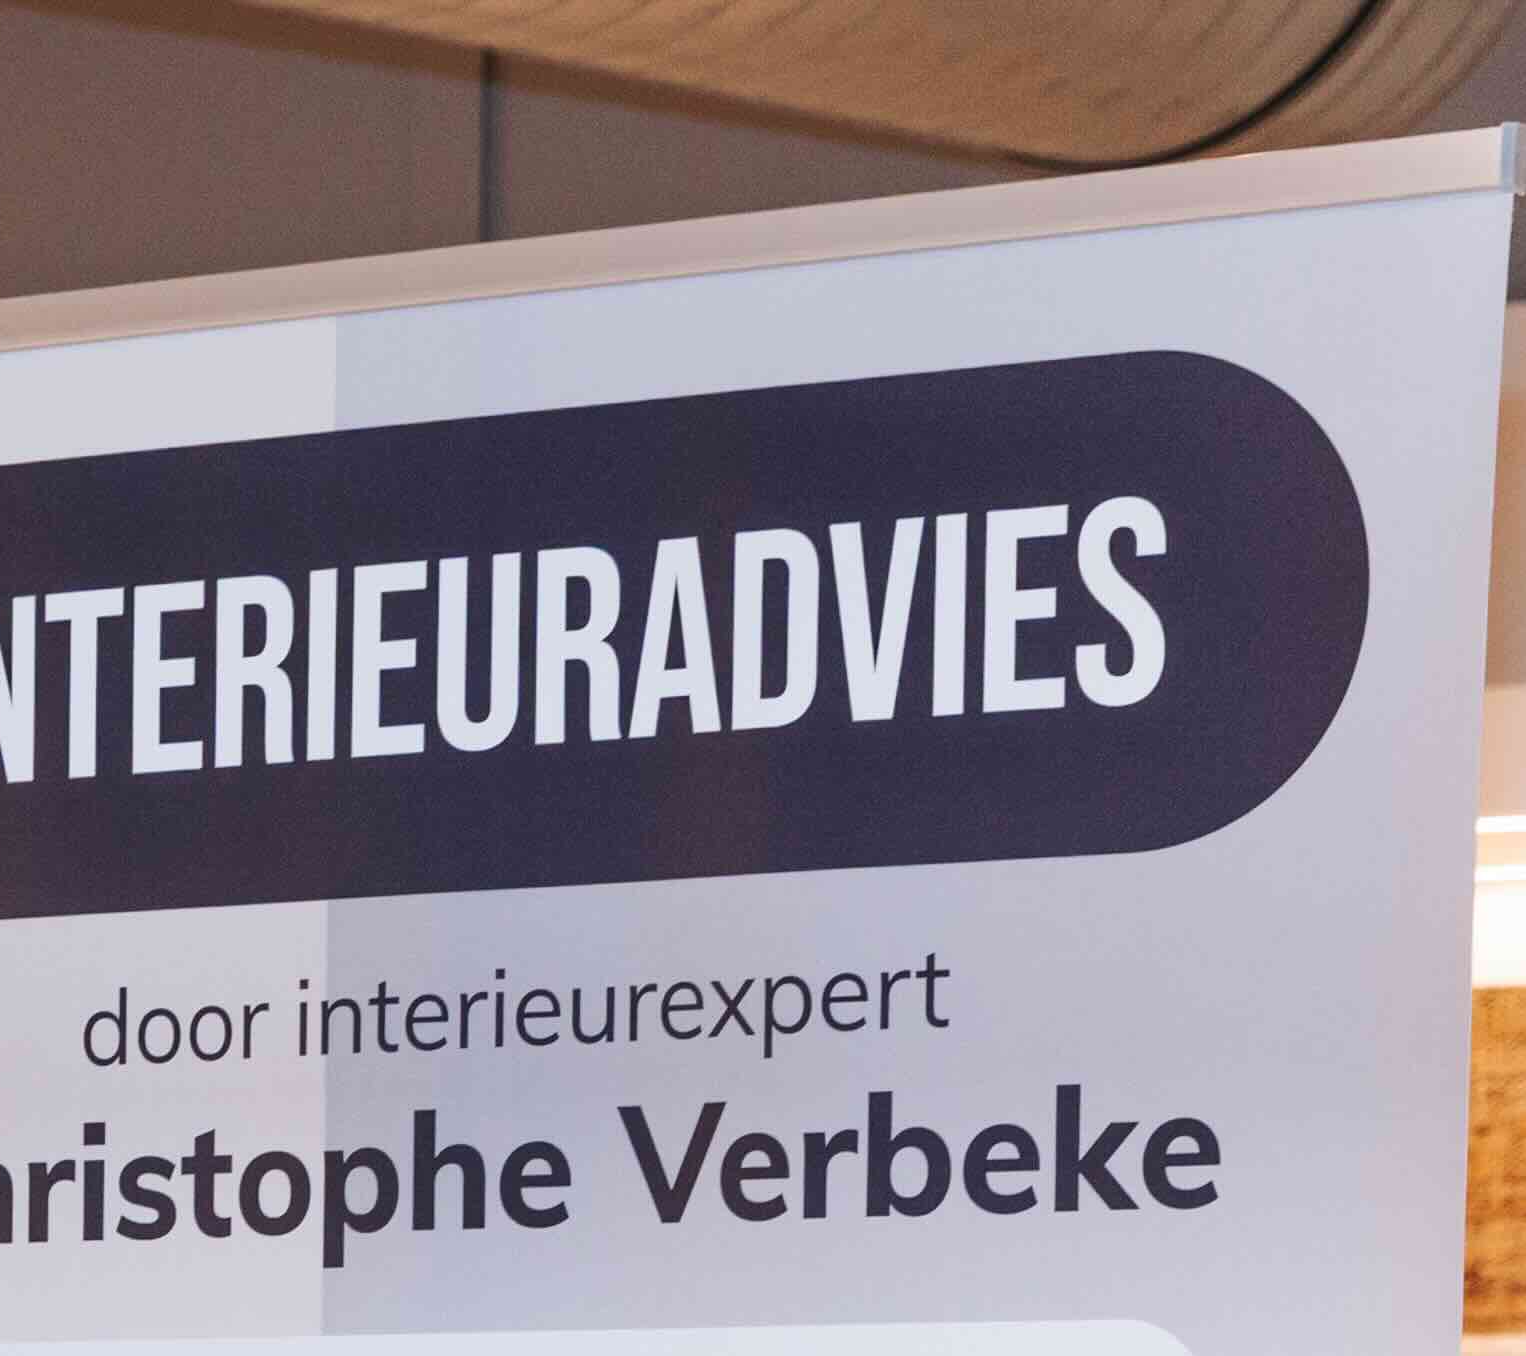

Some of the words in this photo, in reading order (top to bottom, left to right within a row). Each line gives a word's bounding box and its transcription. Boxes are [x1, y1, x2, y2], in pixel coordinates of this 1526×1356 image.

[82, 985, 271, 1068] door
[298, 951, 952, 1060] interieurexpert
[615, 1082, 1222, 1225] Verbeke
